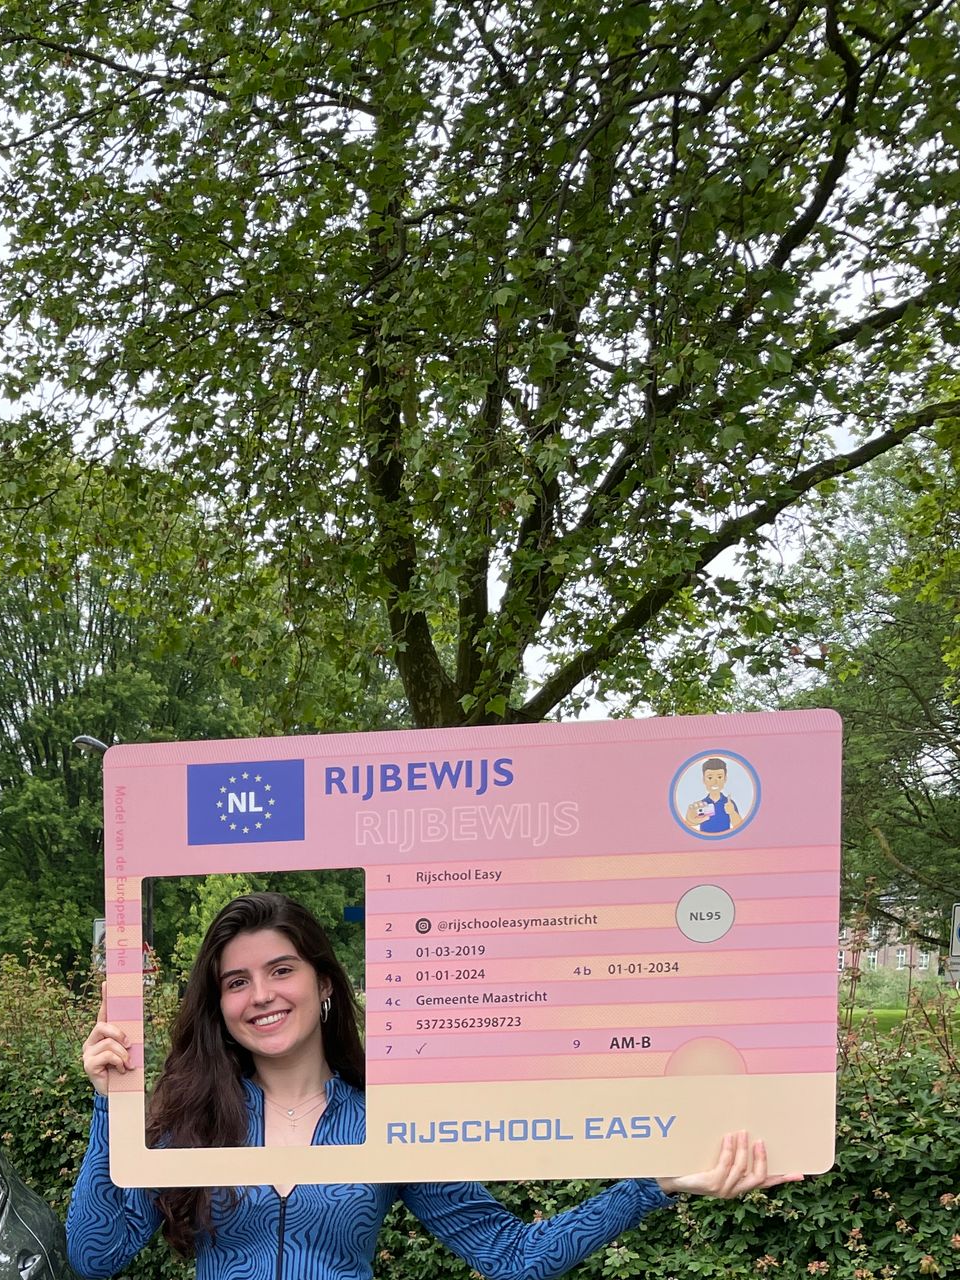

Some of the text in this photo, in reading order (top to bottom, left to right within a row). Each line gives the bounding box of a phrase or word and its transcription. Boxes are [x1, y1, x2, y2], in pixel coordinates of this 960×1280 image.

[324, 758, 514, 801] RIJBEWIJS
[227, 791, 264, 814] NL
[355, 801, 581, 852] RIJBEWIJS
[114, 785, 129, 967] Model van de Europese Unie
[386, 874, 392, 883] 1
[415, 869, 503, 885] Rijschool Easy
[437, 913, 598, 933] @rijschooleasymaastricht
[689, 911, 722, 922] NL95
[385, 922, 393, 932] 2
[385, 949, 393, 959] 3
[415, 944, 486, 958] 01-03-2019
[415, 968, 486, 982] 01-01-2024
[607, 961, 680, 975] 01-01-2034
[415, 990, 548, 1006] Gemeente Maastricht
[385, 1021, 393, 1031] 5
[415, 1016, 522, 1030] 53723562398723
[573, 1039, 581, 1049] 9
[609, 1035, 652, 1050] AM-B
[385, 1045, 393, 1055] 7
[386, 1115, 678, 1145] RIJSCHOOL EASY
